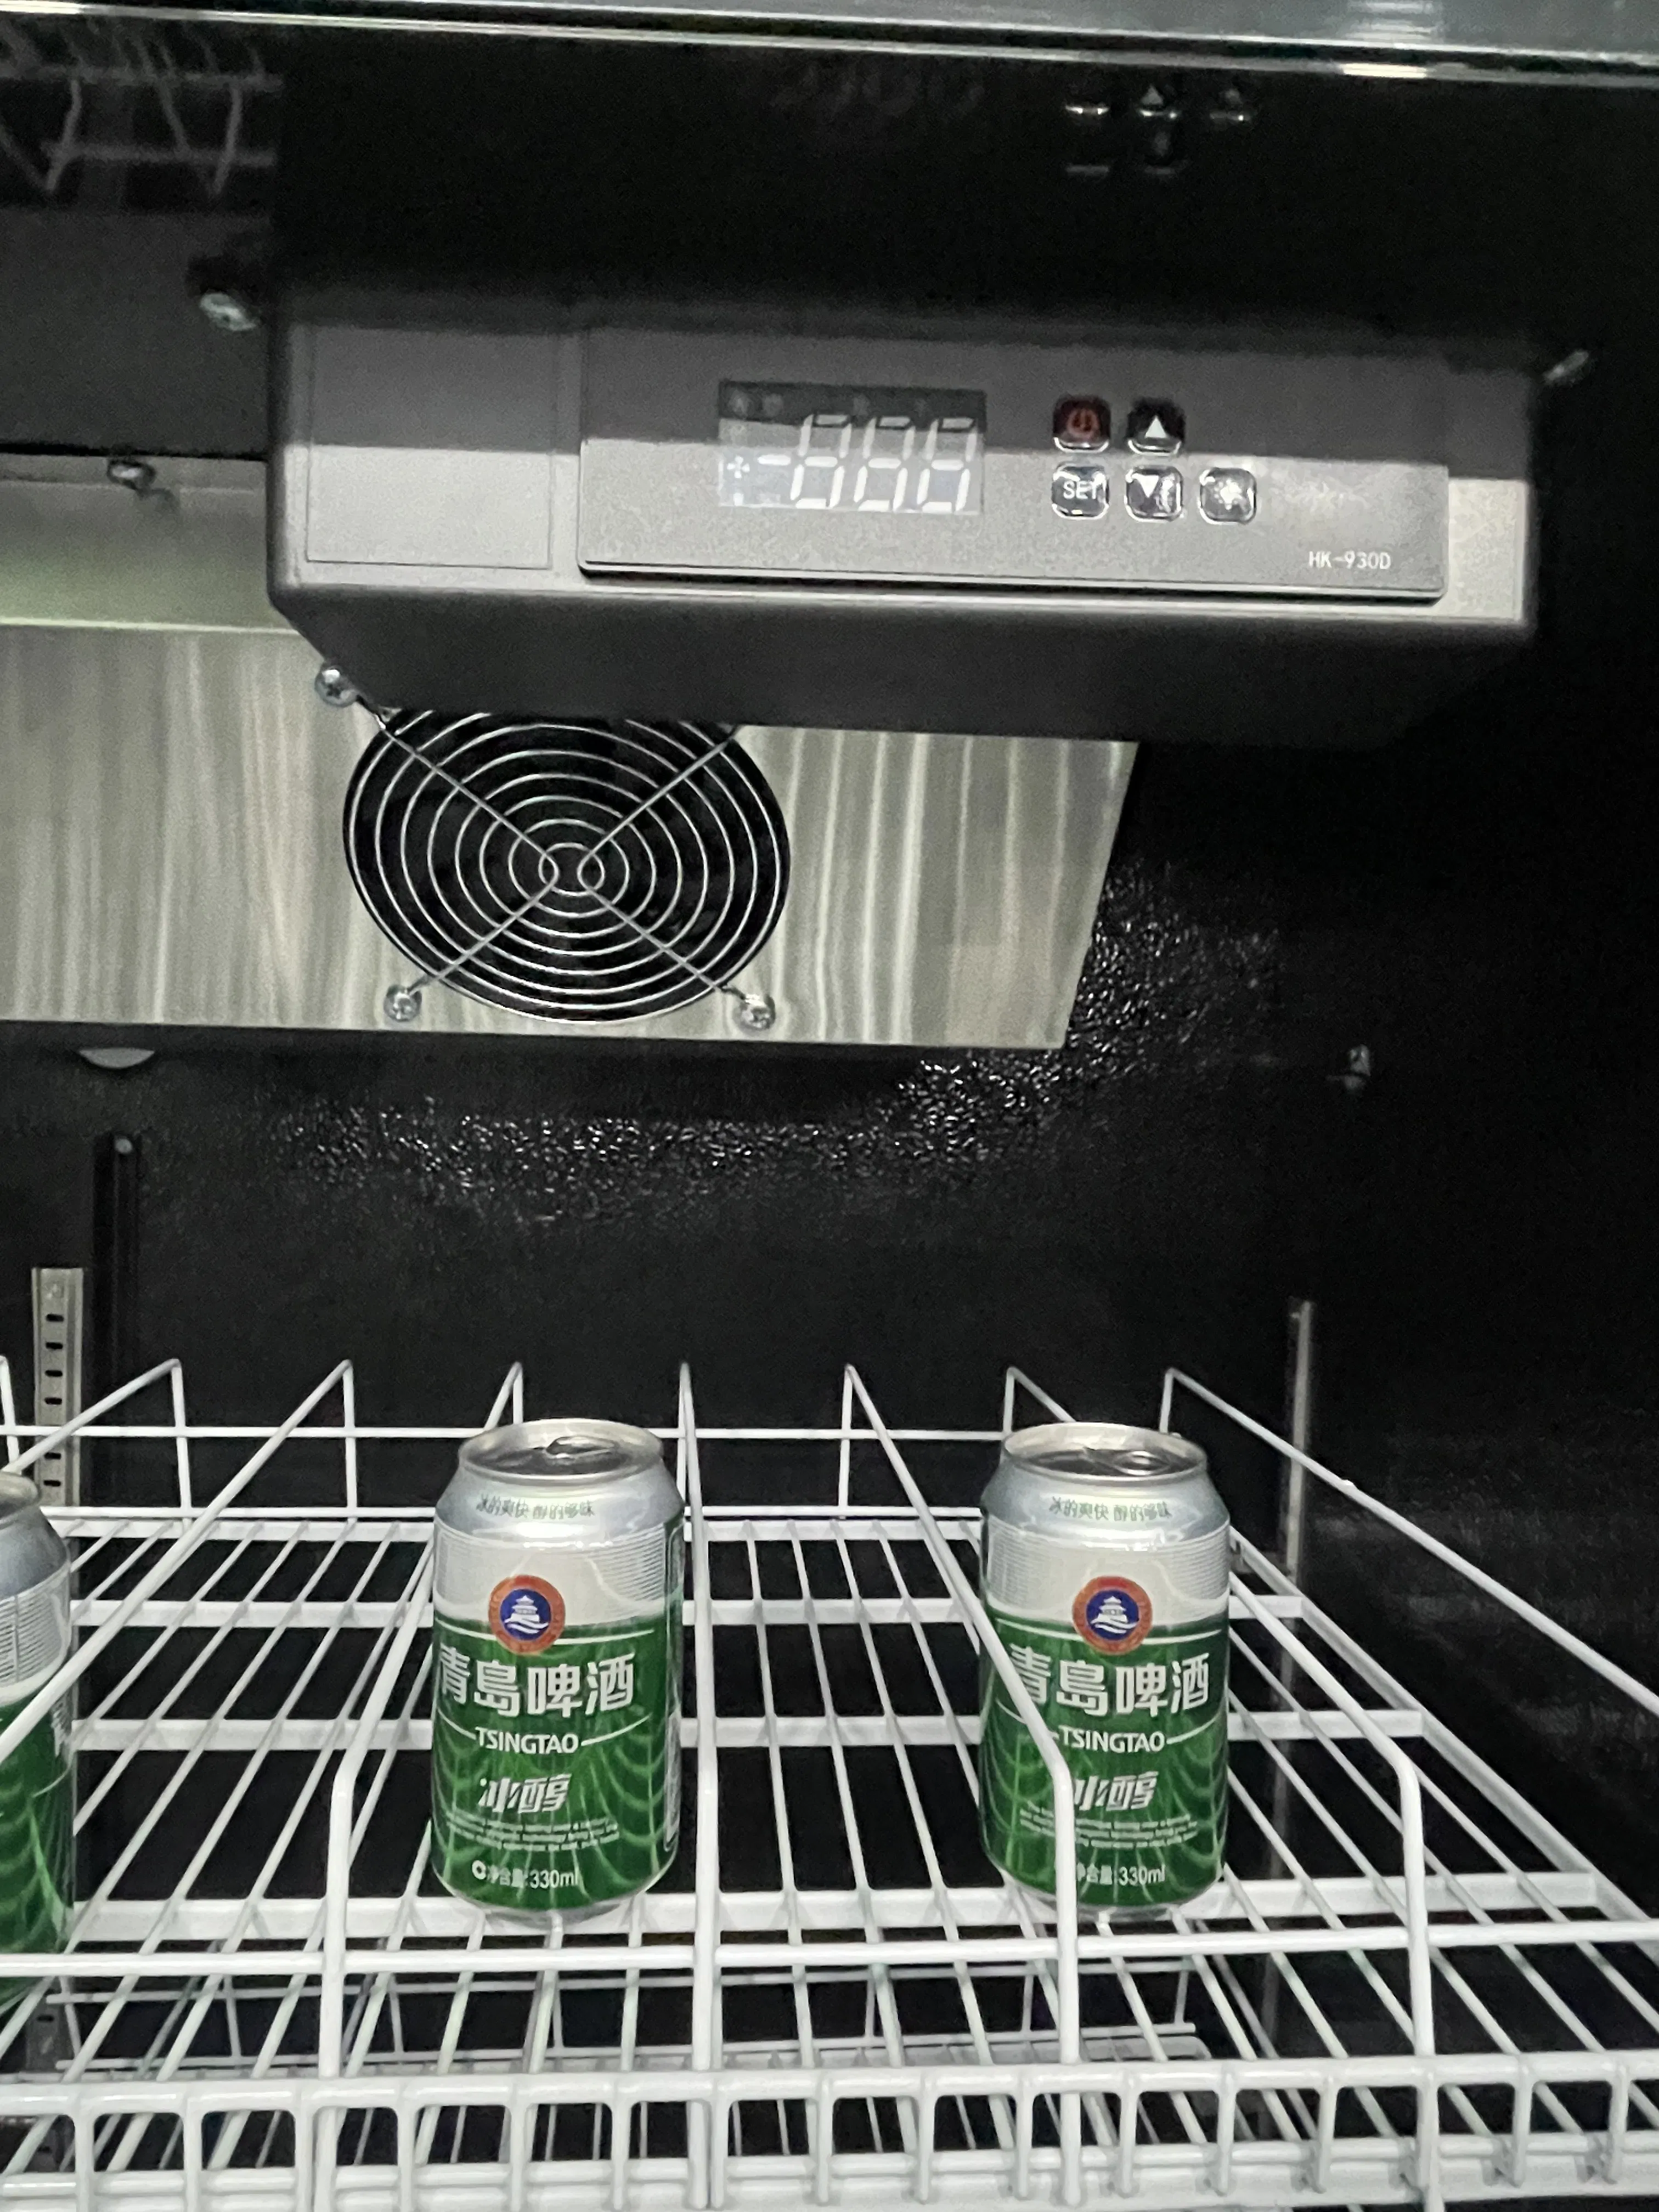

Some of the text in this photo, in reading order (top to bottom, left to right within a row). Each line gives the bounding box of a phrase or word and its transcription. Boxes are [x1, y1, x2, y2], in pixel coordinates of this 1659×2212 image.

[1063, 478, 1098, 500] SET
[1308, 550, 1391, 569] HK-930D
[439, 1642, 635, 1718] 青岛啤酒
[475, 1726, 579, 1754] TSINGTAO
[1059, 1725, 1165, 1753] TSINGTAO
[478, 1773, 573, 1814] 冰醇
